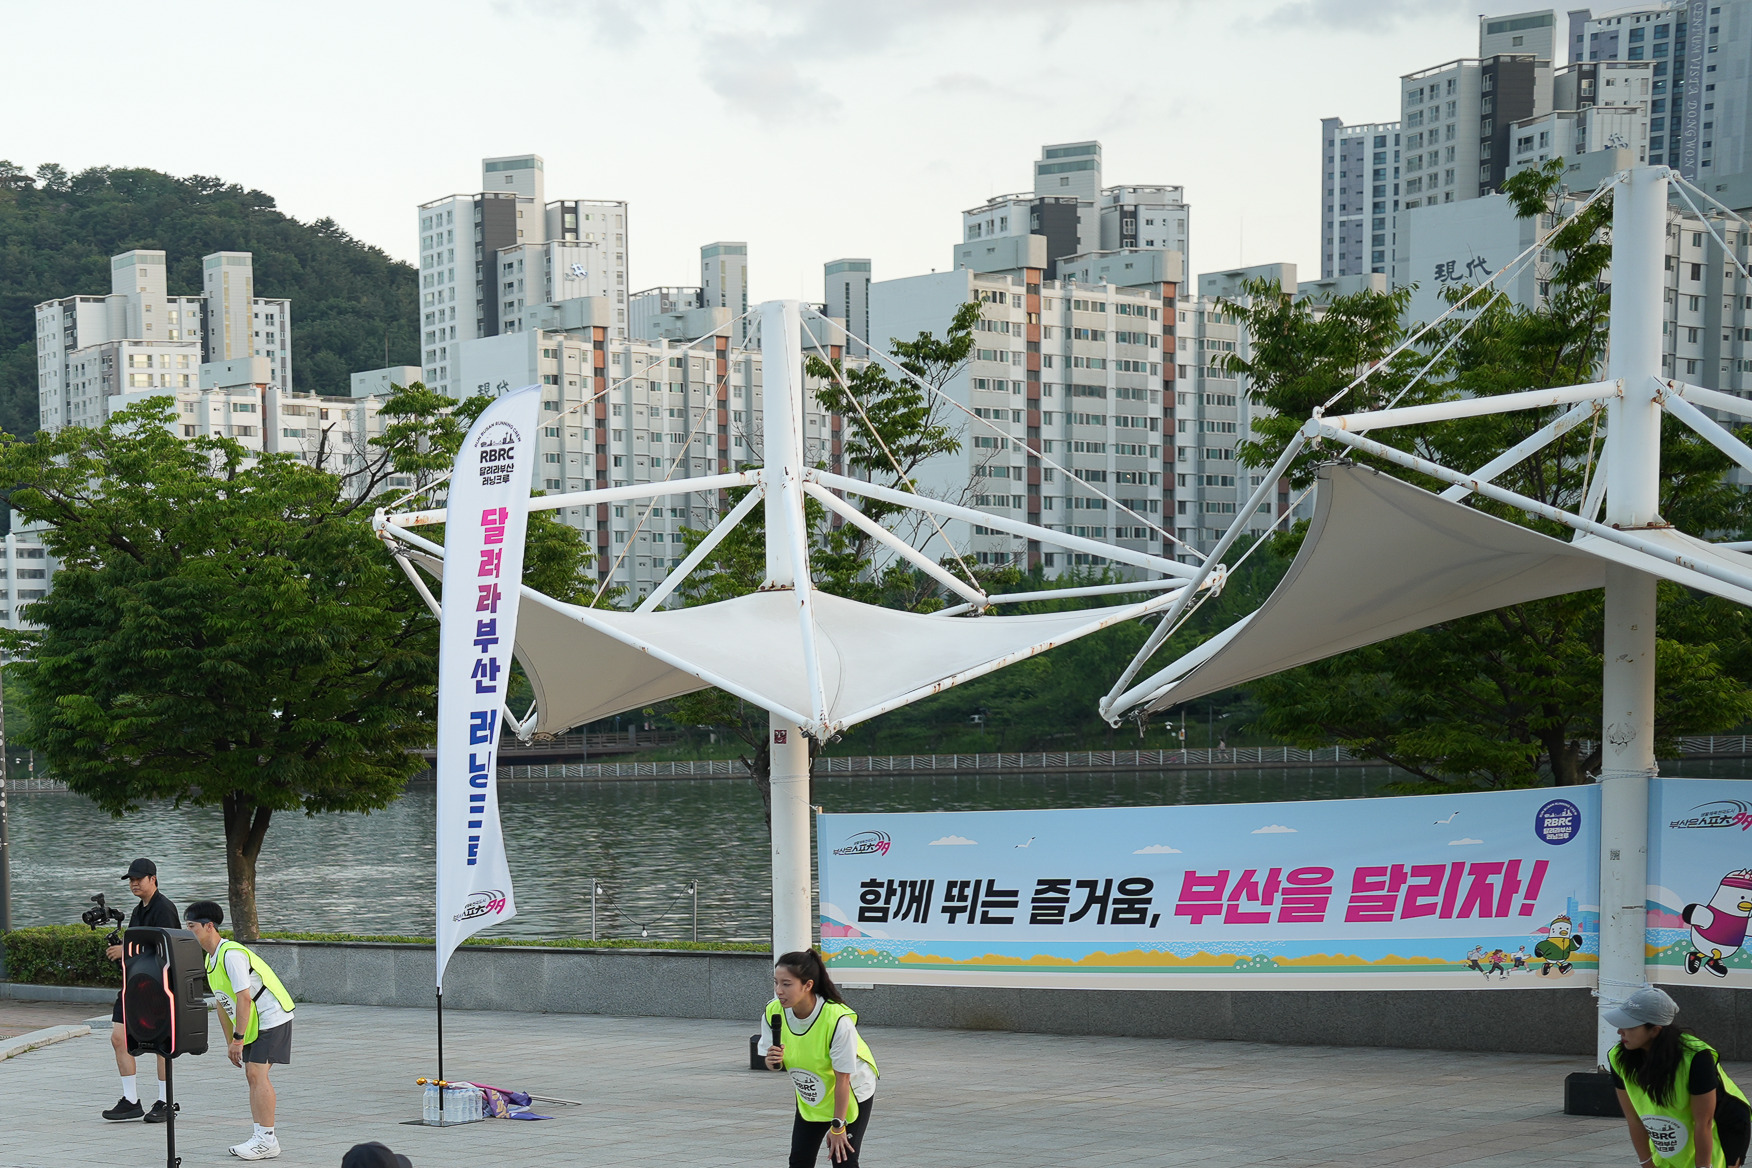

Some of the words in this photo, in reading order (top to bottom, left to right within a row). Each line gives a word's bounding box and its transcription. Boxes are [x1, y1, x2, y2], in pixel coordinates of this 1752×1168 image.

[480, 446, 515, 464] RBRC
[479, 463, 515, 477] 달려라부산
[482, 474, 510, 486] 러닝크루
[471, 506, 509, 694] 달려라부산
[1544, 817, 1573, 827] RBRC
[857, 877, 935, 924] 함께
[940, 879, 1019, 925] 뛰는
[1029, 877, 1161, 928] 즐거움,
[1174, 865, 1333, 925] 부산을
[1344, 857, 1549, 923] 달리자!
